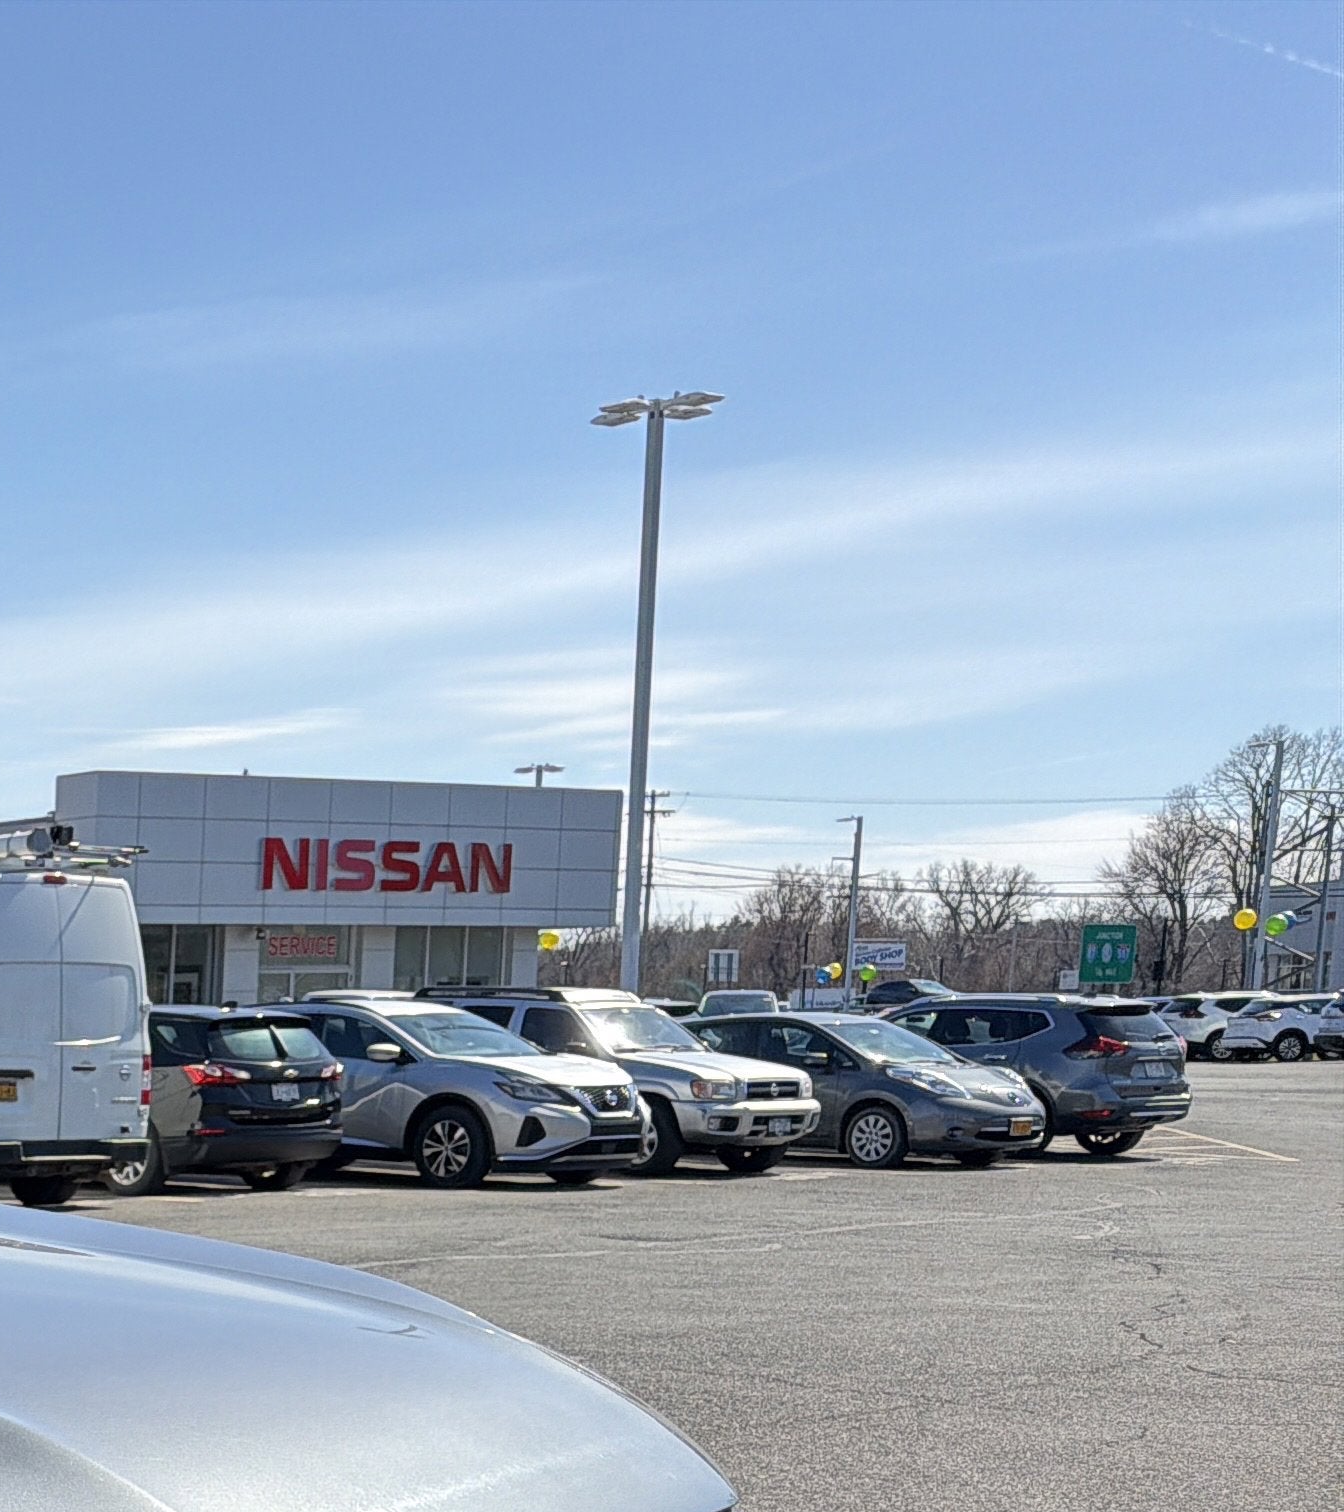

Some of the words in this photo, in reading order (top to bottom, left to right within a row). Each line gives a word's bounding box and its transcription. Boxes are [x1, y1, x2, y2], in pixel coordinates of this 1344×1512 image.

[261, 838, 512, 892] NISSAN
[268, 935, 336, 957] SERVICE
[879, 949, 903, 961] SHOP
